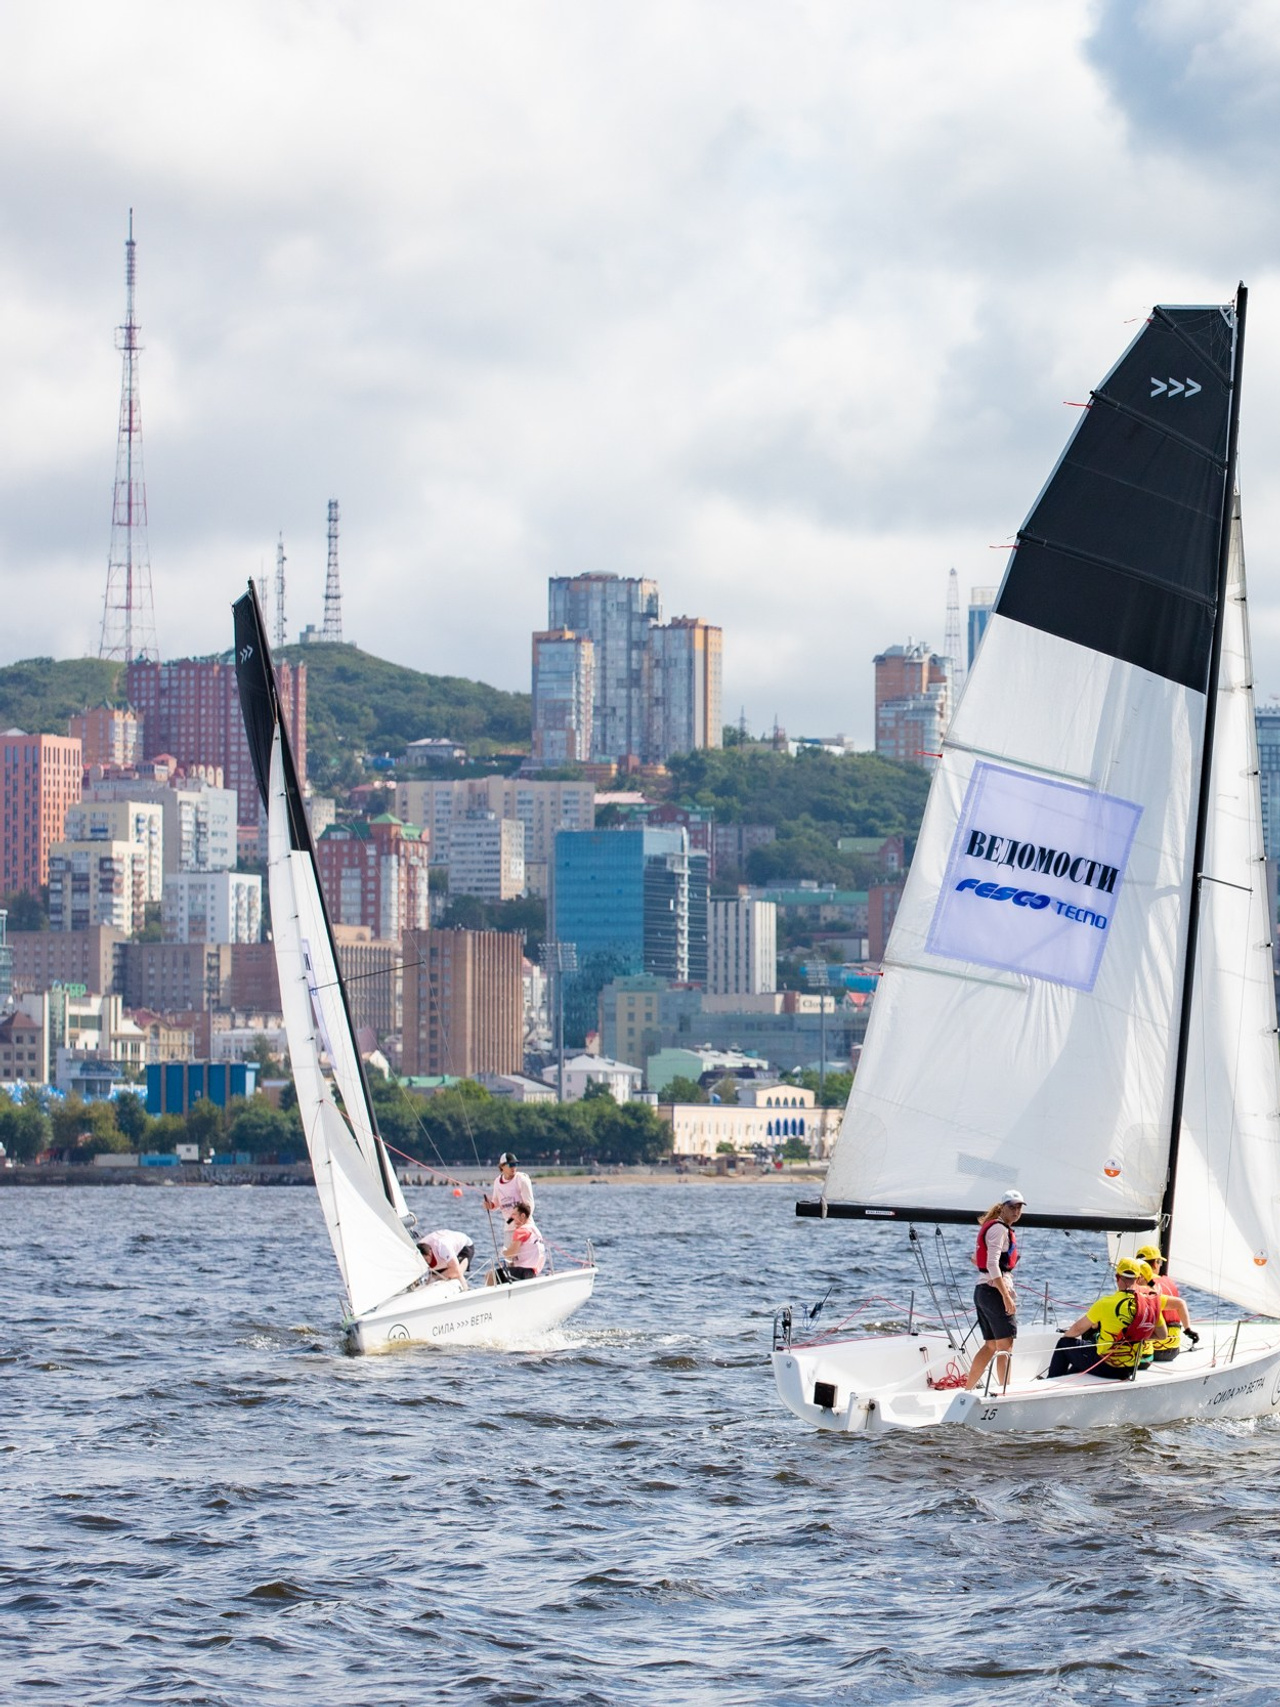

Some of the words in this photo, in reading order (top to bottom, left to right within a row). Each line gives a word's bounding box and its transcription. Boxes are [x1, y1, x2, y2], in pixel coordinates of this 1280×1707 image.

[965, 829, 1120, 894] ВЕДОМОСТИ
[955, 878, 1051, 910] FESCO
[1056, 901, 1107, 930] TECNO
[64, 982, 87, 998] СБЕР
[432, 1323, 455, 1337] СИЛА
[470, 1312, 493, 1327] ВЕТРА
[980, 1408, 998, 1421] 15
